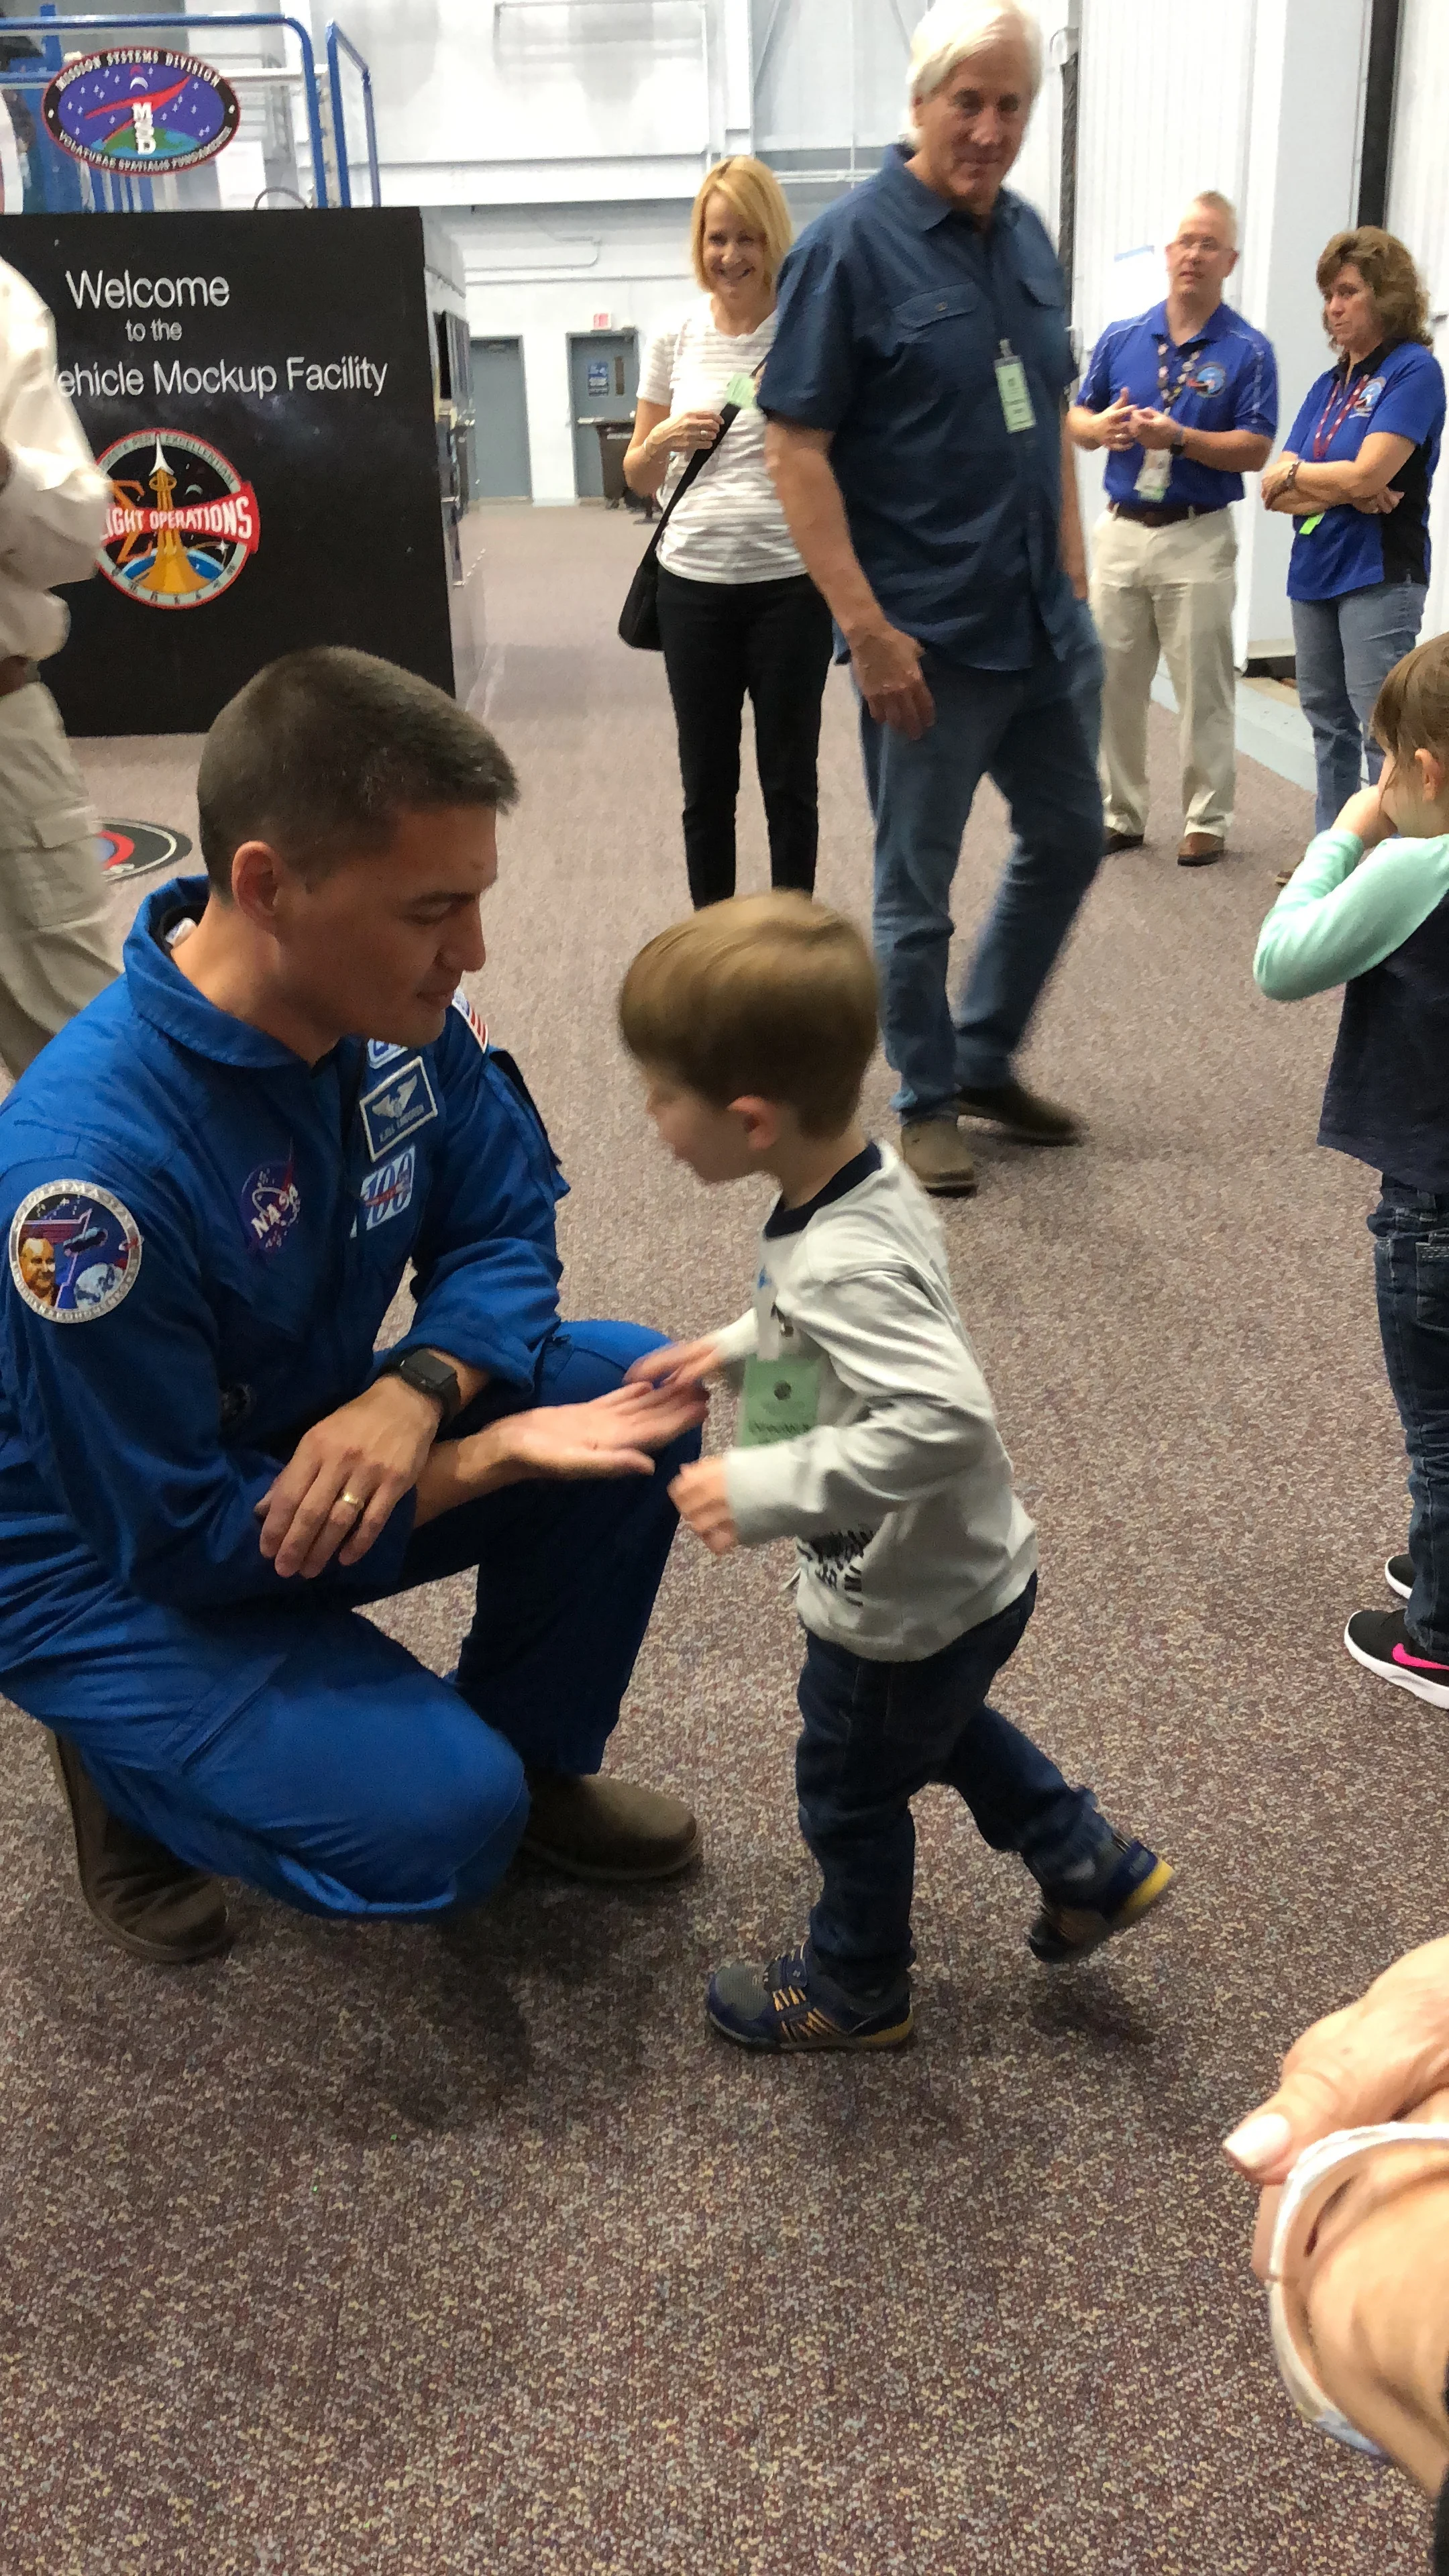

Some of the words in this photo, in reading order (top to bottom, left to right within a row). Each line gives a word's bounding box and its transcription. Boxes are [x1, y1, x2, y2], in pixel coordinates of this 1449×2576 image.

[165, 52, 221, 88] DIVISION
[65, 269, 230, 309] Welcome
[125, 319, 146, 342] to
[150, 317, 182, 341] the
[57, 361, 144, 397] ehicle
[154, 358, 277, 400] Mockup
[286, 356, 388, 396] Facility
[100, 507, 145, 541] IGHT
[149, 496, 252, 539] OPERATIONS
[251, 1183, 299, 1239] NASA
